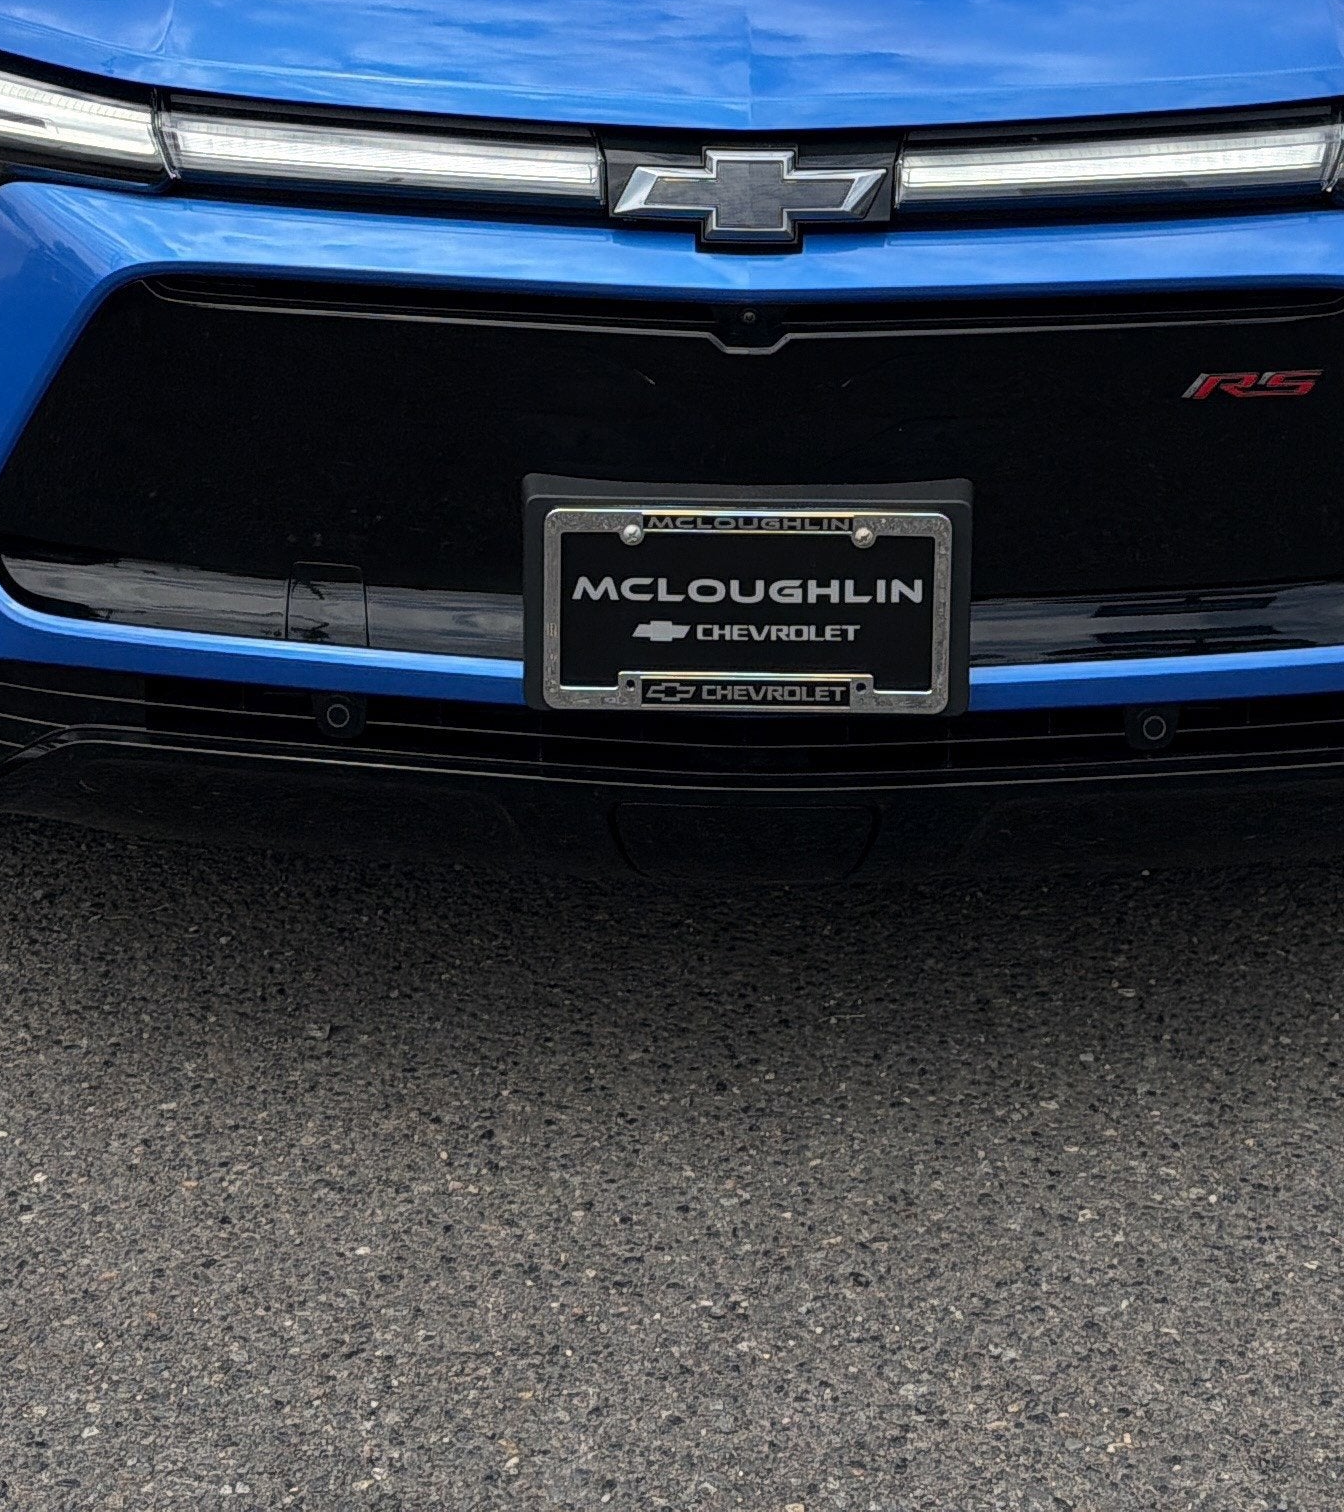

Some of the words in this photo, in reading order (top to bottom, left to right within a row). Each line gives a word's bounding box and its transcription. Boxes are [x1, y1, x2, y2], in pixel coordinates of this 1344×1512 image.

[1181, 369, 1324, 399] RS
[648, 516, 851, 531] MCLOUGHLIN
[572, 576, 923, 604] MCLOUGHLIN
[696, 624, 861, 642] CHEVROLET
[701, 685, 847, 702] CHEVROLET
